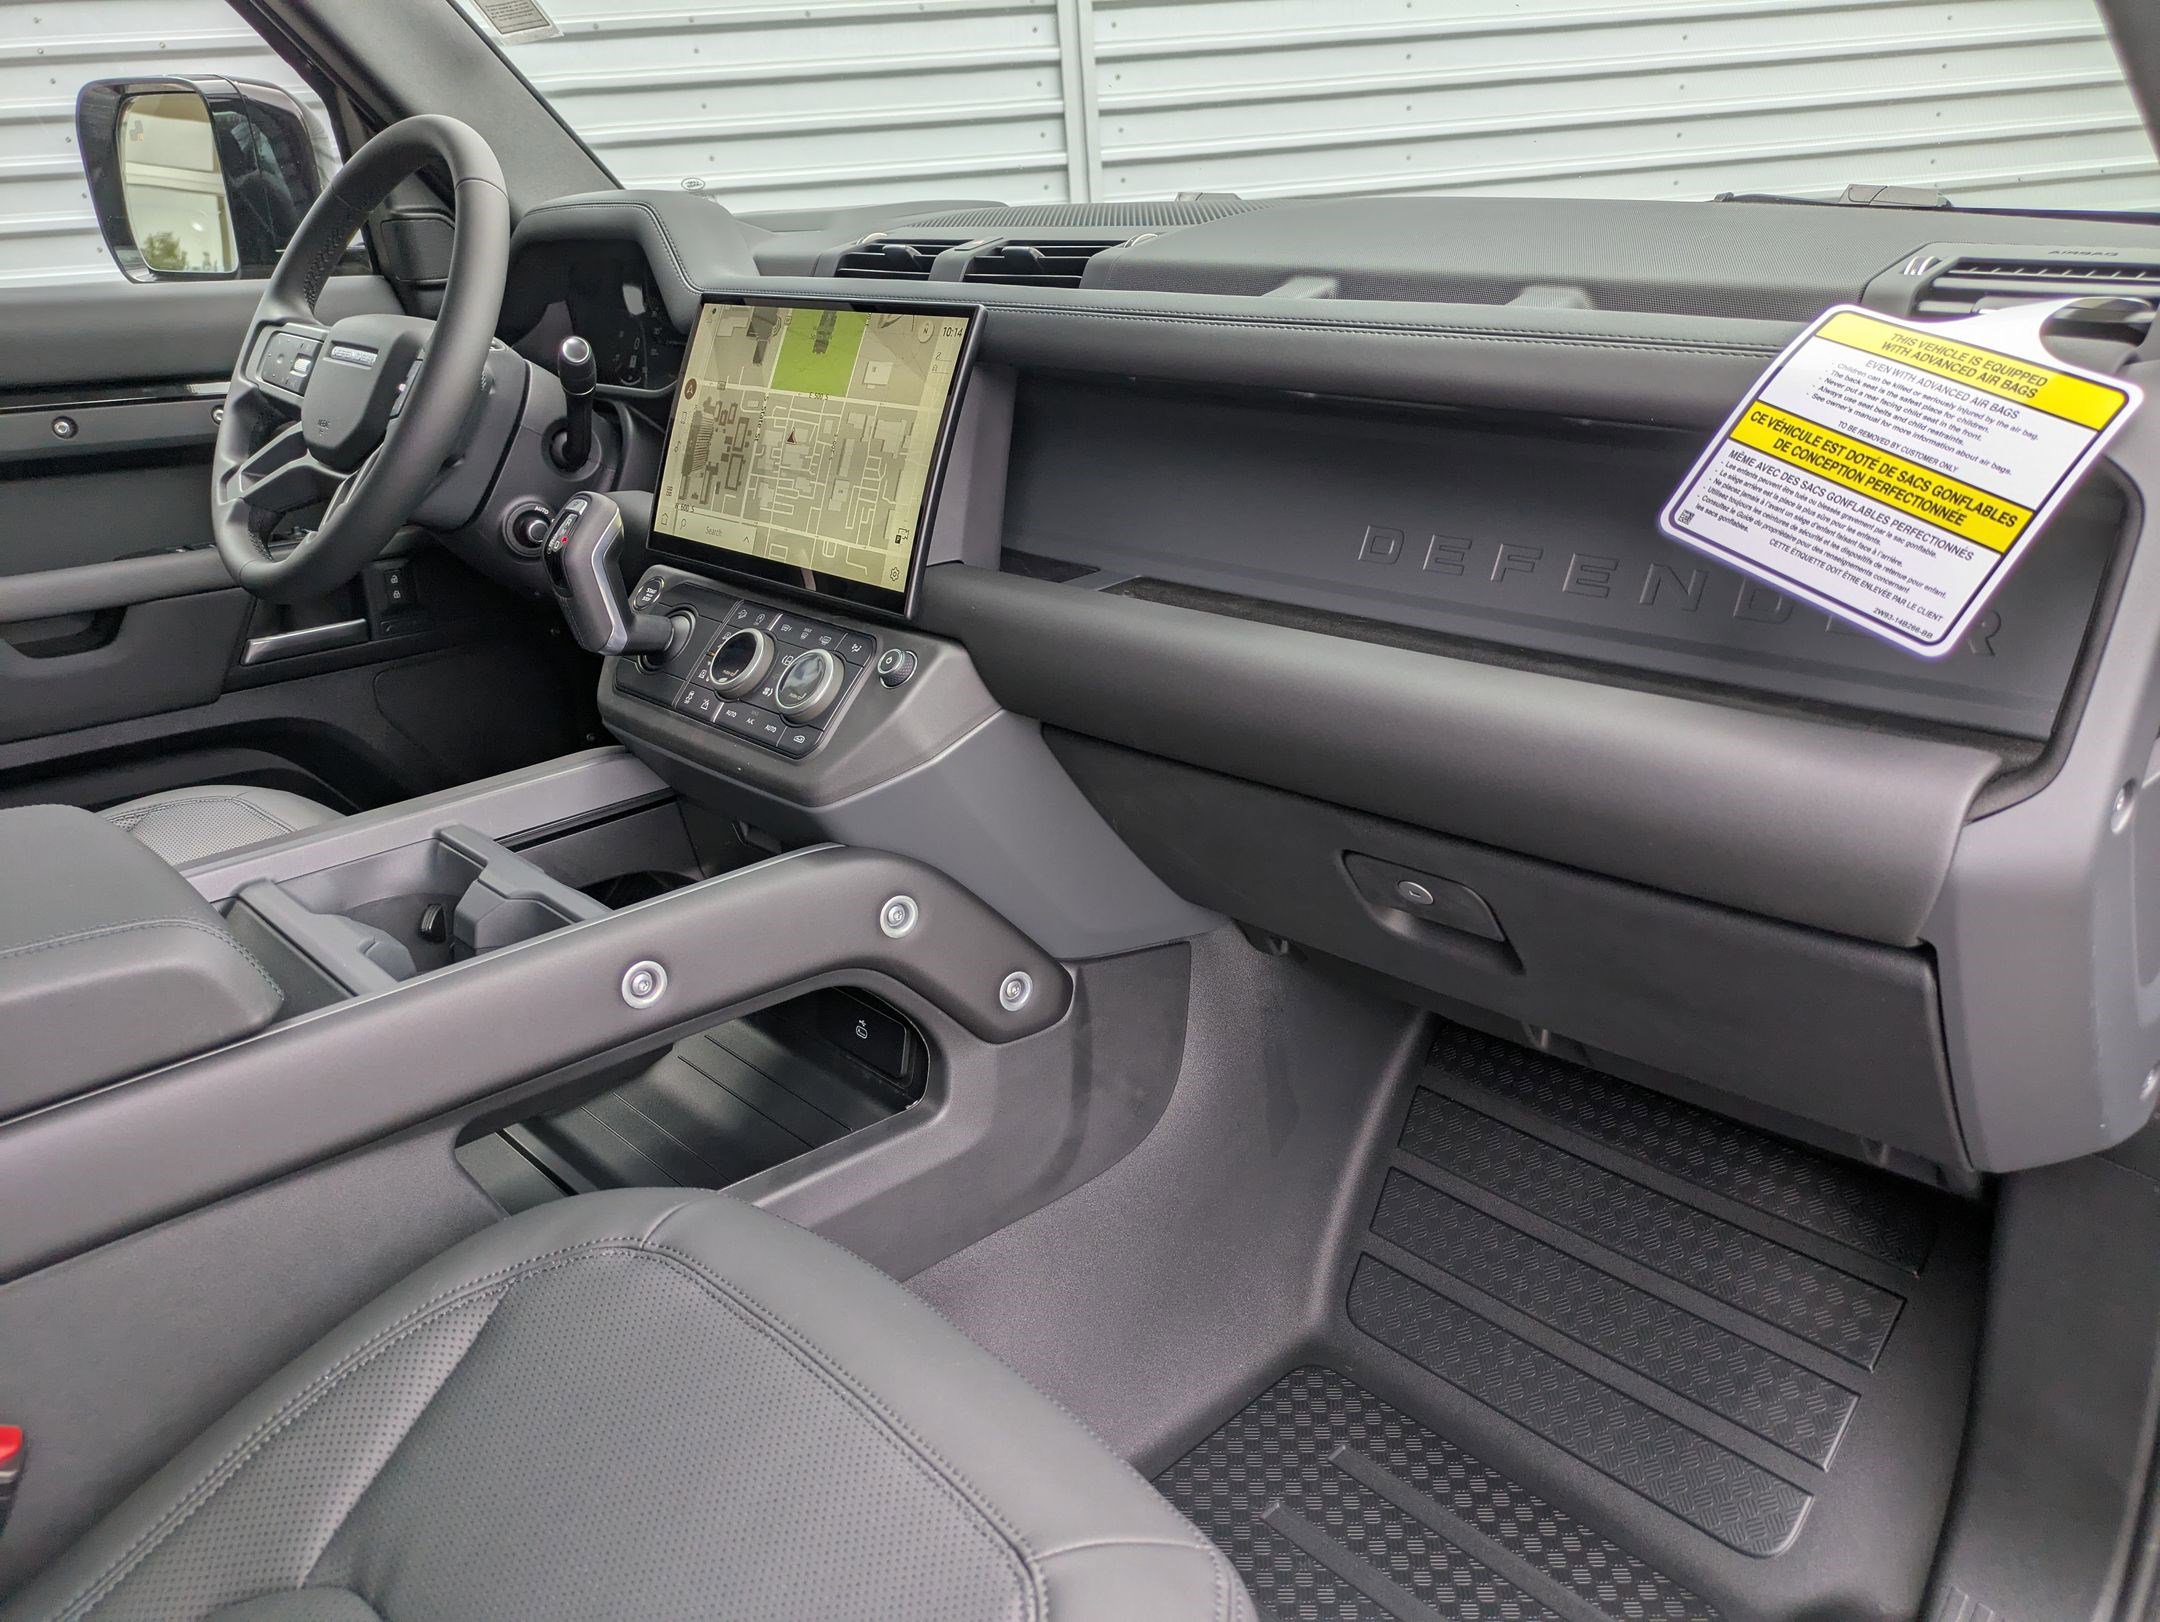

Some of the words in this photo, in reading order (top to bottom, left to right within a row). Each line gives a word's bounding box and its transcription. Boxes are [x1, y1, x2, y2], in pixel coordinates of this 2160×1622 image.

[942, 326, 963, 337] 10:14
[1890, 333, 1919, 347] THIS
[1918, 340, 1970, 362] VEHICLE
[1967, 355, 1984, 366] IS
[1982, 360, 2048, 387] EQUIPPED
[1865, 359, 1893, 374] EVEN
[1891, 368, 1918, 383] WITH
[1916, 377, 1971, 402] ADVANCED
[1969, 396, 1990, 409] AIR
[1989, 403, 2020, 420] BAGS
[1881, 341, 1913, 357] WITH
[1910, 351, 1978, 378] ADVANCED
[1976, 372, 2001, 386] AIR
[2000, 379, 2039, 399] BAGS
[1818, 385, 1843, 399] Always
[1857, 401, 1874, 411] seat
[1873, 406, 1892, 418] belts
[1907, 420, 1928, 431] child
[1926, 427, 1964, 446] restraints.
[1823, 377, 1846, 389] Never
[1863, 393, 1880, 402] rear
[1879, 398, 1903, 412] facing
[1902, 408, 1923, 418] child
[1922, 415, 1940, 425] seat
[1961, 428, 1982, 442] front.
[1837, 363, 1867, 379] Children
[1891, 382, 1913, 394] killed
[1921, 394, 1957, 411] seriously
[1956, 405, 1986, 420] injured
[2022, 429, 2040, 441] bag.
[1844, 374, 1861, 386] back
[1862, 382, 1879, 392] seat
[1898, 396, 1923, 408] safest
[1920, 404, 1943, 416] place
[1956, 417, 1989, 433] children.
[1825, 399, 1854, 414] owner's
[1853, 410, 1881, 424] manual
[1891, 424, 1912, 436] more
[1911, 431, 1956, 453] information
[1955, 449, 1979, 462] about
[1990, 462, 2013, 475] bags.
[1838, 420, 1848, 430] TO
[1846, 424, 1858, 434] BE
[1856, 428, 1891, 446] REMOVED
[1889, 441, 1901, 450] BY
[1900, 446, 1940, 466] CUSTOMER
[1938, 461, 1958, 473] ONLY
[1750, 410, 1770, 426] CE
[1767, 416, 1824, 448] VÉHICULE
[1820, 439, 1848, 457] EST
[1844, 449, 1880, 471] DOTÉ
[1877, 462, 1899, 479] DE
[1896, 470, 1932, 492] SACS
[1931, 484, 2018, 528] GONFLABLES
[1772, 437, 1793, 453] DE
[1790, 445, 1867, 484] CONCEPTION
[1864, 475, 1968, 527] PERFECTIONNÉE
[534, 506, 550, 515] AUTO
[705, 526, 722, 536] Search
[1704, 508, 1719, 518] sacs
[1717, 514, 1749, 533] gonflables.
[1720, 482, 1742, 495] placez
[1738, 490, 1761, 504] jamais
[1764, 500, 1786, 515] l'avant
[1810, 521, 1837, 537] d'enfant
[1835, 532, 1859, 547] faisant
[1857, 541, 1872, 553] face
[1728, 449, 1757, 468] MÊME
[1754, 461, 1781, 478] AVEC
[1779, 471, 1801, 486] DES
[1799, 480, 1827, 498] SACS
[1826, 491, 1891, 525] GONFLABLES
[1889, 518, 1975, 561] PERFECTIONNÉS
[1736, 467, 1759, 480] enfants
[1757, 476, 1783, 491] peuvent
[1840, 512, 1875, 531] gravement
[1905, 540, 1938, 558] gonflable.
[1777, 496, 1796, 508] place
[1800, 506, 1817, 517] plus
[1829, 519, 1847, 530] pour
[1856, 530, 1881, 546] enfants.
[1701, 494, 1731, 513] Consultez
[1736, 510, 1755, 523] Guide
[1795, 538, 1812, 549] pour
[1823, 551, 1873, 577] renseignements
[1872, 574, 1910, 594] concernant
[1707, 486, 1729, 501] Utilisez
[1728, 495, 1753, 511] toujours
[1761, 512, 1790, 528] ceintures
[1840, 546, 1874, 566] dispositifs
[1882, 566, 1908, 581] retenue
[1906, 577, 1925, 588] pour
[1923, 585, 1946, 599] enfant.
[1357, 526, 2002, 657] DEFENDR
[1769, 538, 1792, 553] CETTE
[1790, 547, 1827, 569] ÉTIQUETTE
[1824, 563, 1843, 576] DOIT
[1841, 570, 1862, 585] ÊTRE
[1859, 580, 1893, 600] ENLEVÉE
[1891, 594, 1908, 606] PAR
[1905, 601, 1918, 611] LE
[1916, 606, 1944, 622] CLIENT
[725, 709, 737, 718] AUTO
[765, 724, 777, 733] AUTO
